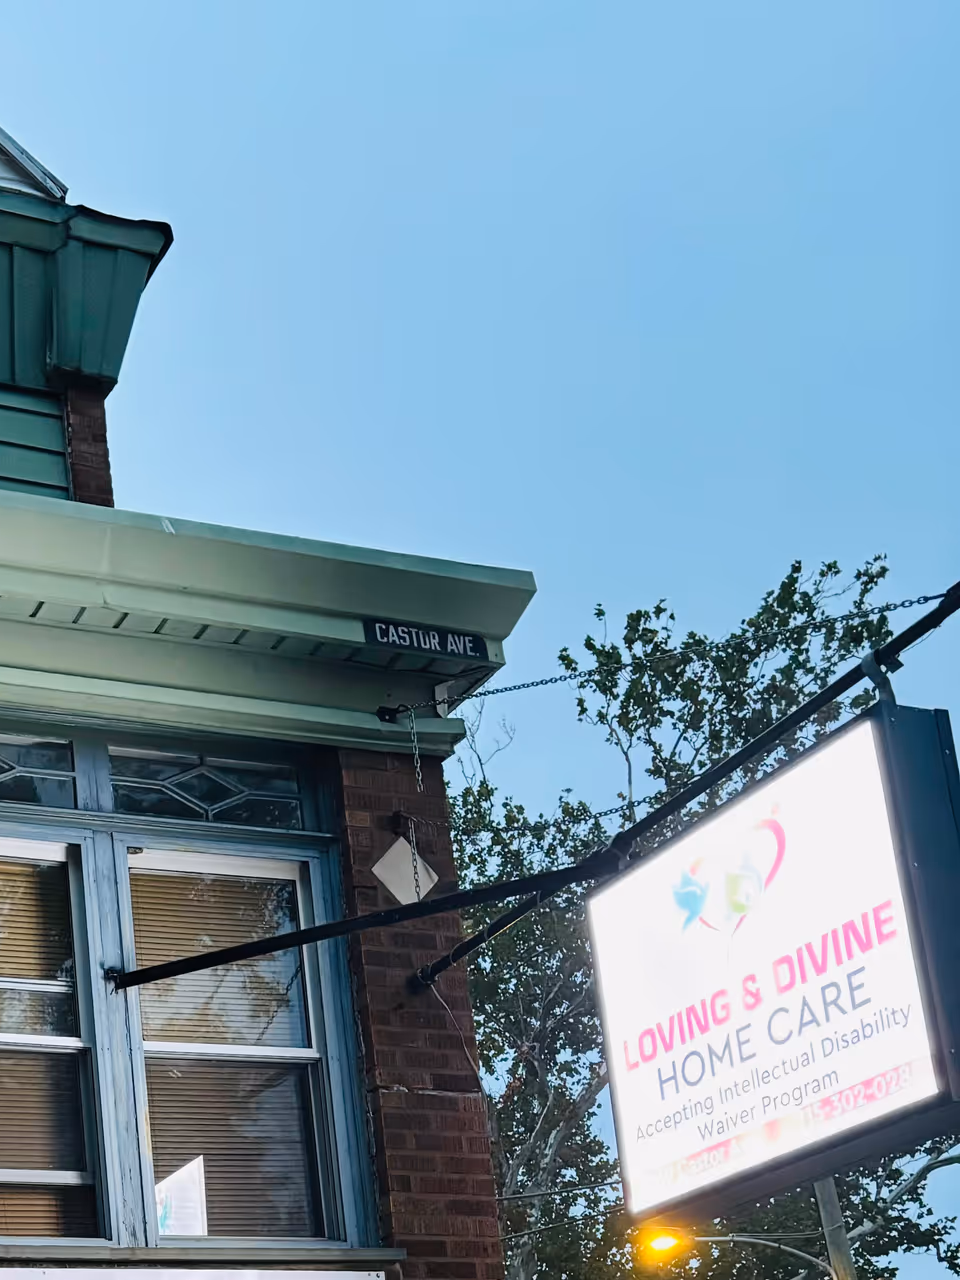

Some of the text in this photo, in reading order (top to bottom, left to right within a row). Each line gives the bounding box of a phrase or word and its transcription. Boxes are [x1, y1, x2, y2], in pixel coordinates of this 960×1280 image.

[375, 623, 480, 656] CASTOR AVE.
[623, 900, 897, 1072] LOVING & DIVINE
[657, 966, 871, 1100] HOME CARE
[636, 1004, 911, 1142] Accepting Intellectual Disability
[697, 1070, 839, 1141] Waiver Program
